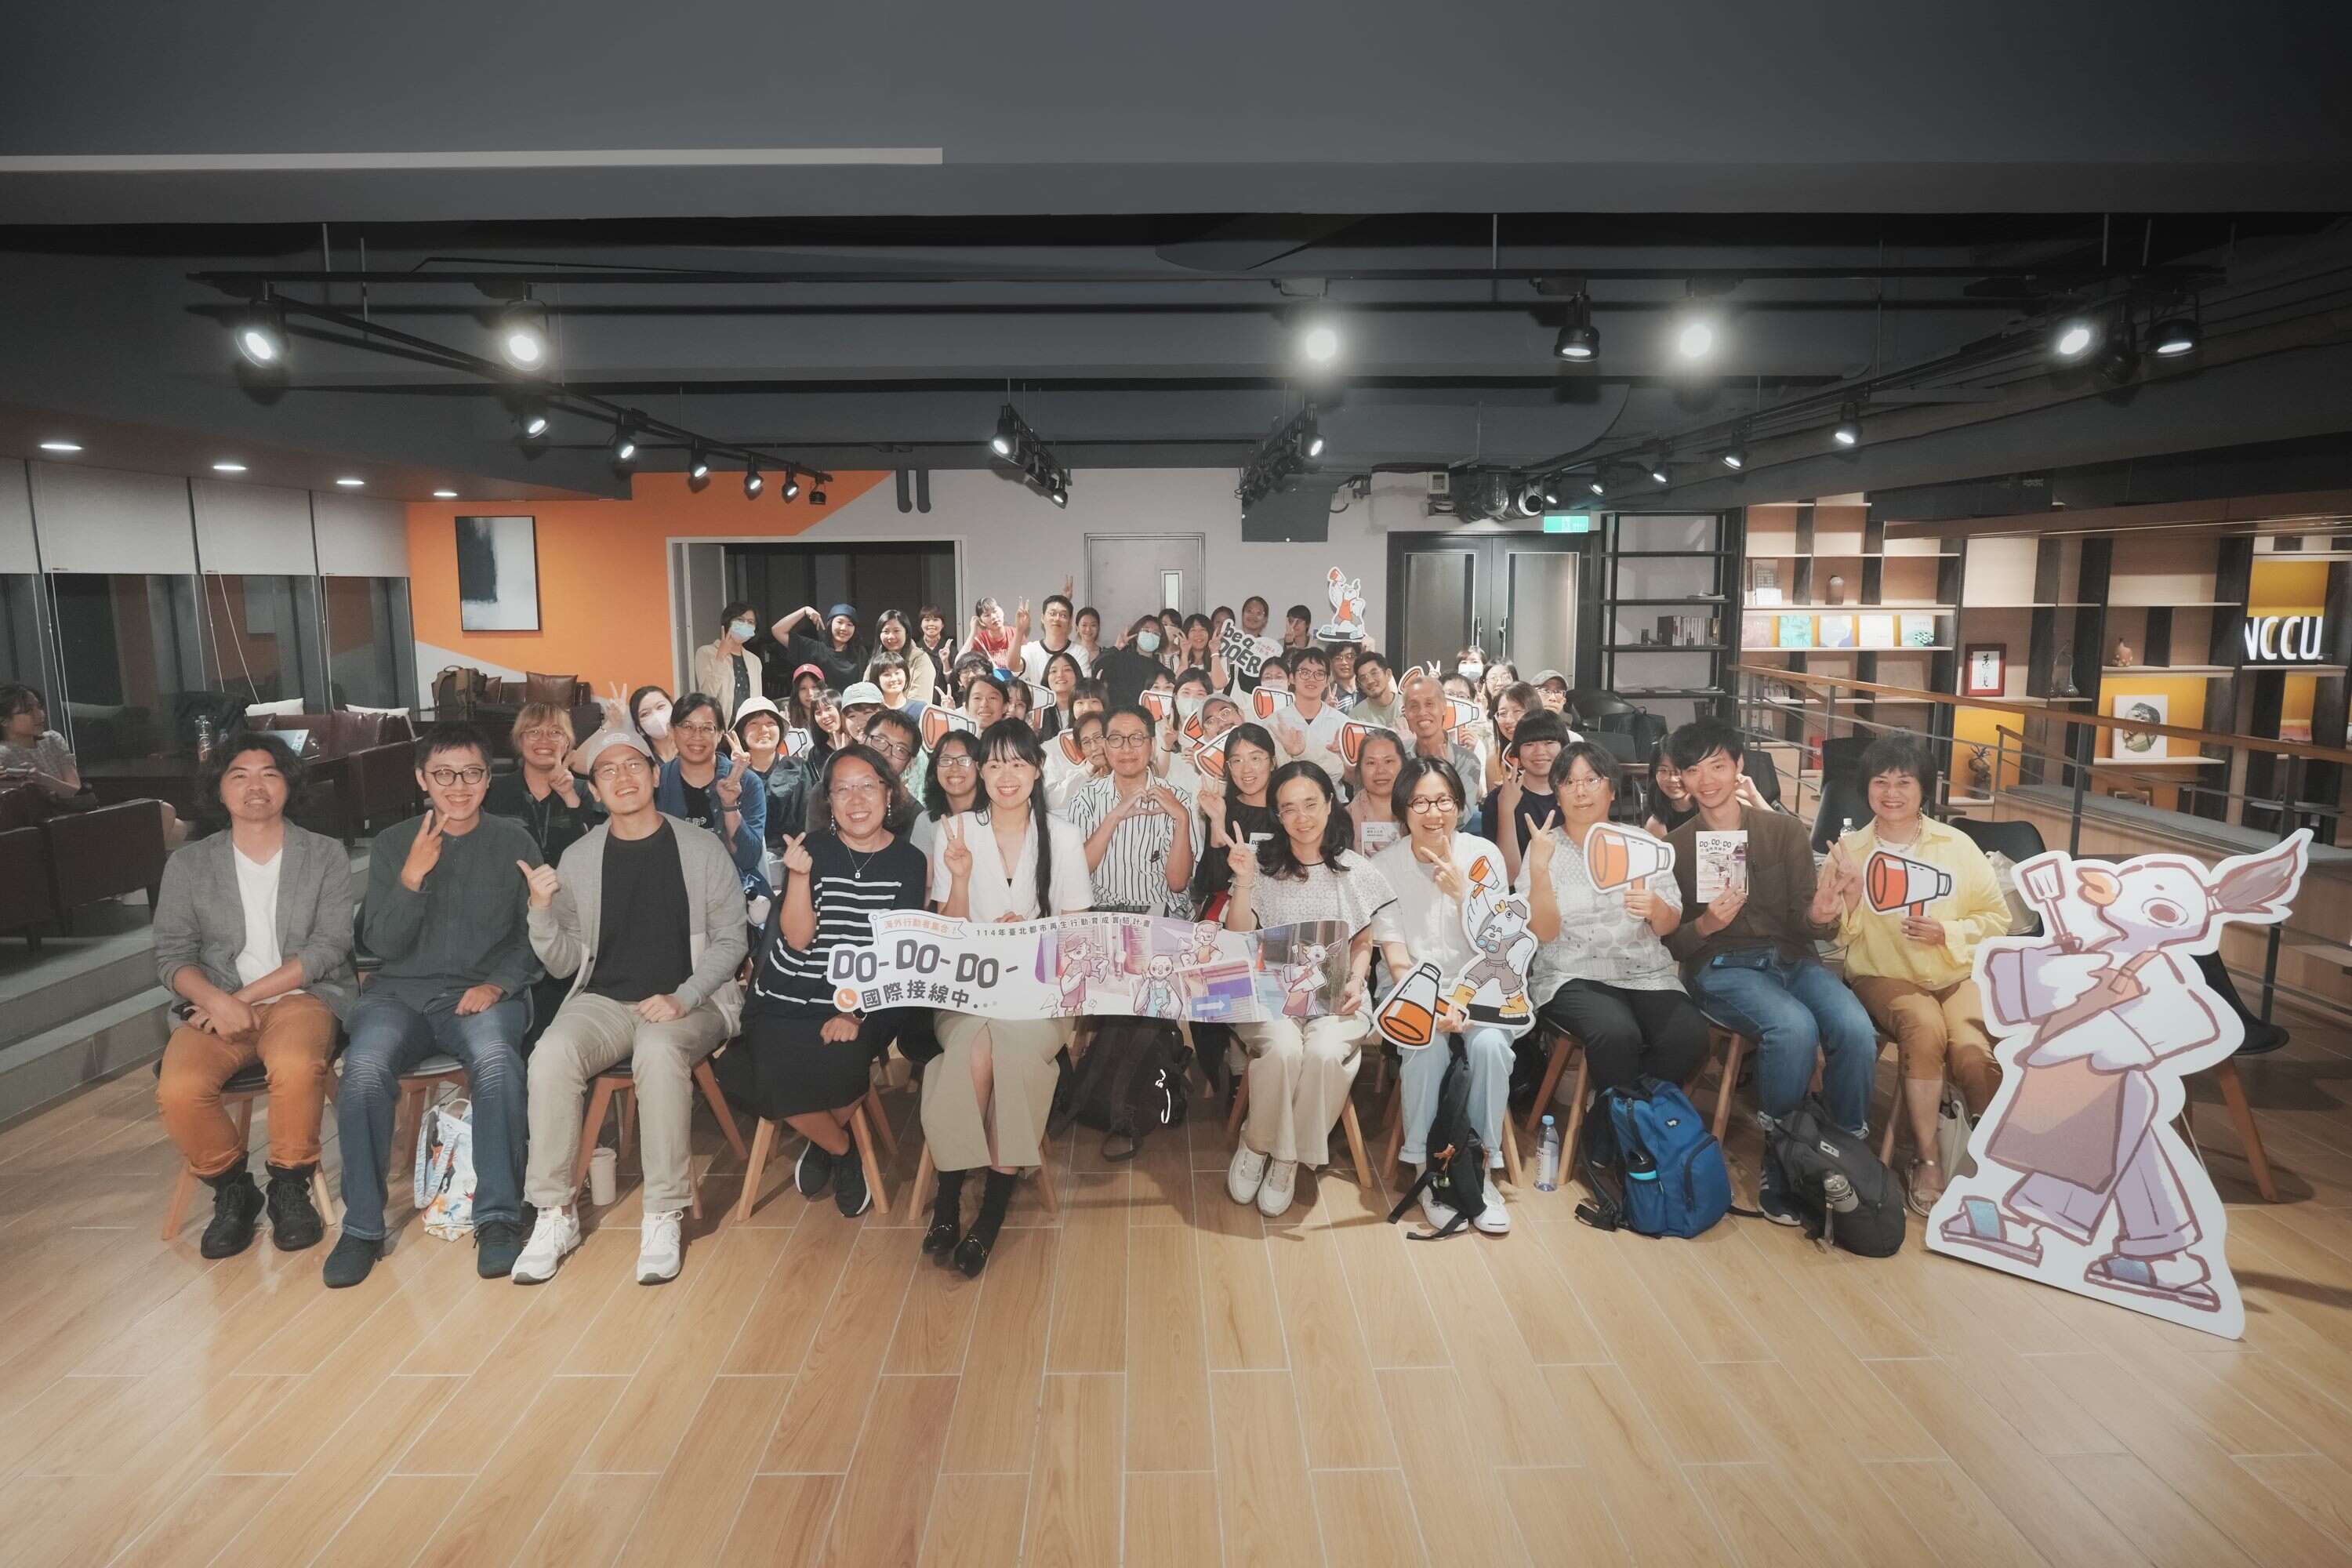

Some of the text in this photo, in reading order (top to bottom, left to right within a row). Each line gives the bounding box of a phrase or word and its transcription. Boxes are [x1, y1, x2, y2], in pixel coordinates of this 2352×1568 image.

[1223, 622, 1254, 649] be a
[2245, 615, 2323, 660] NCCU
[1221, 637, 1261, 673] DOER
